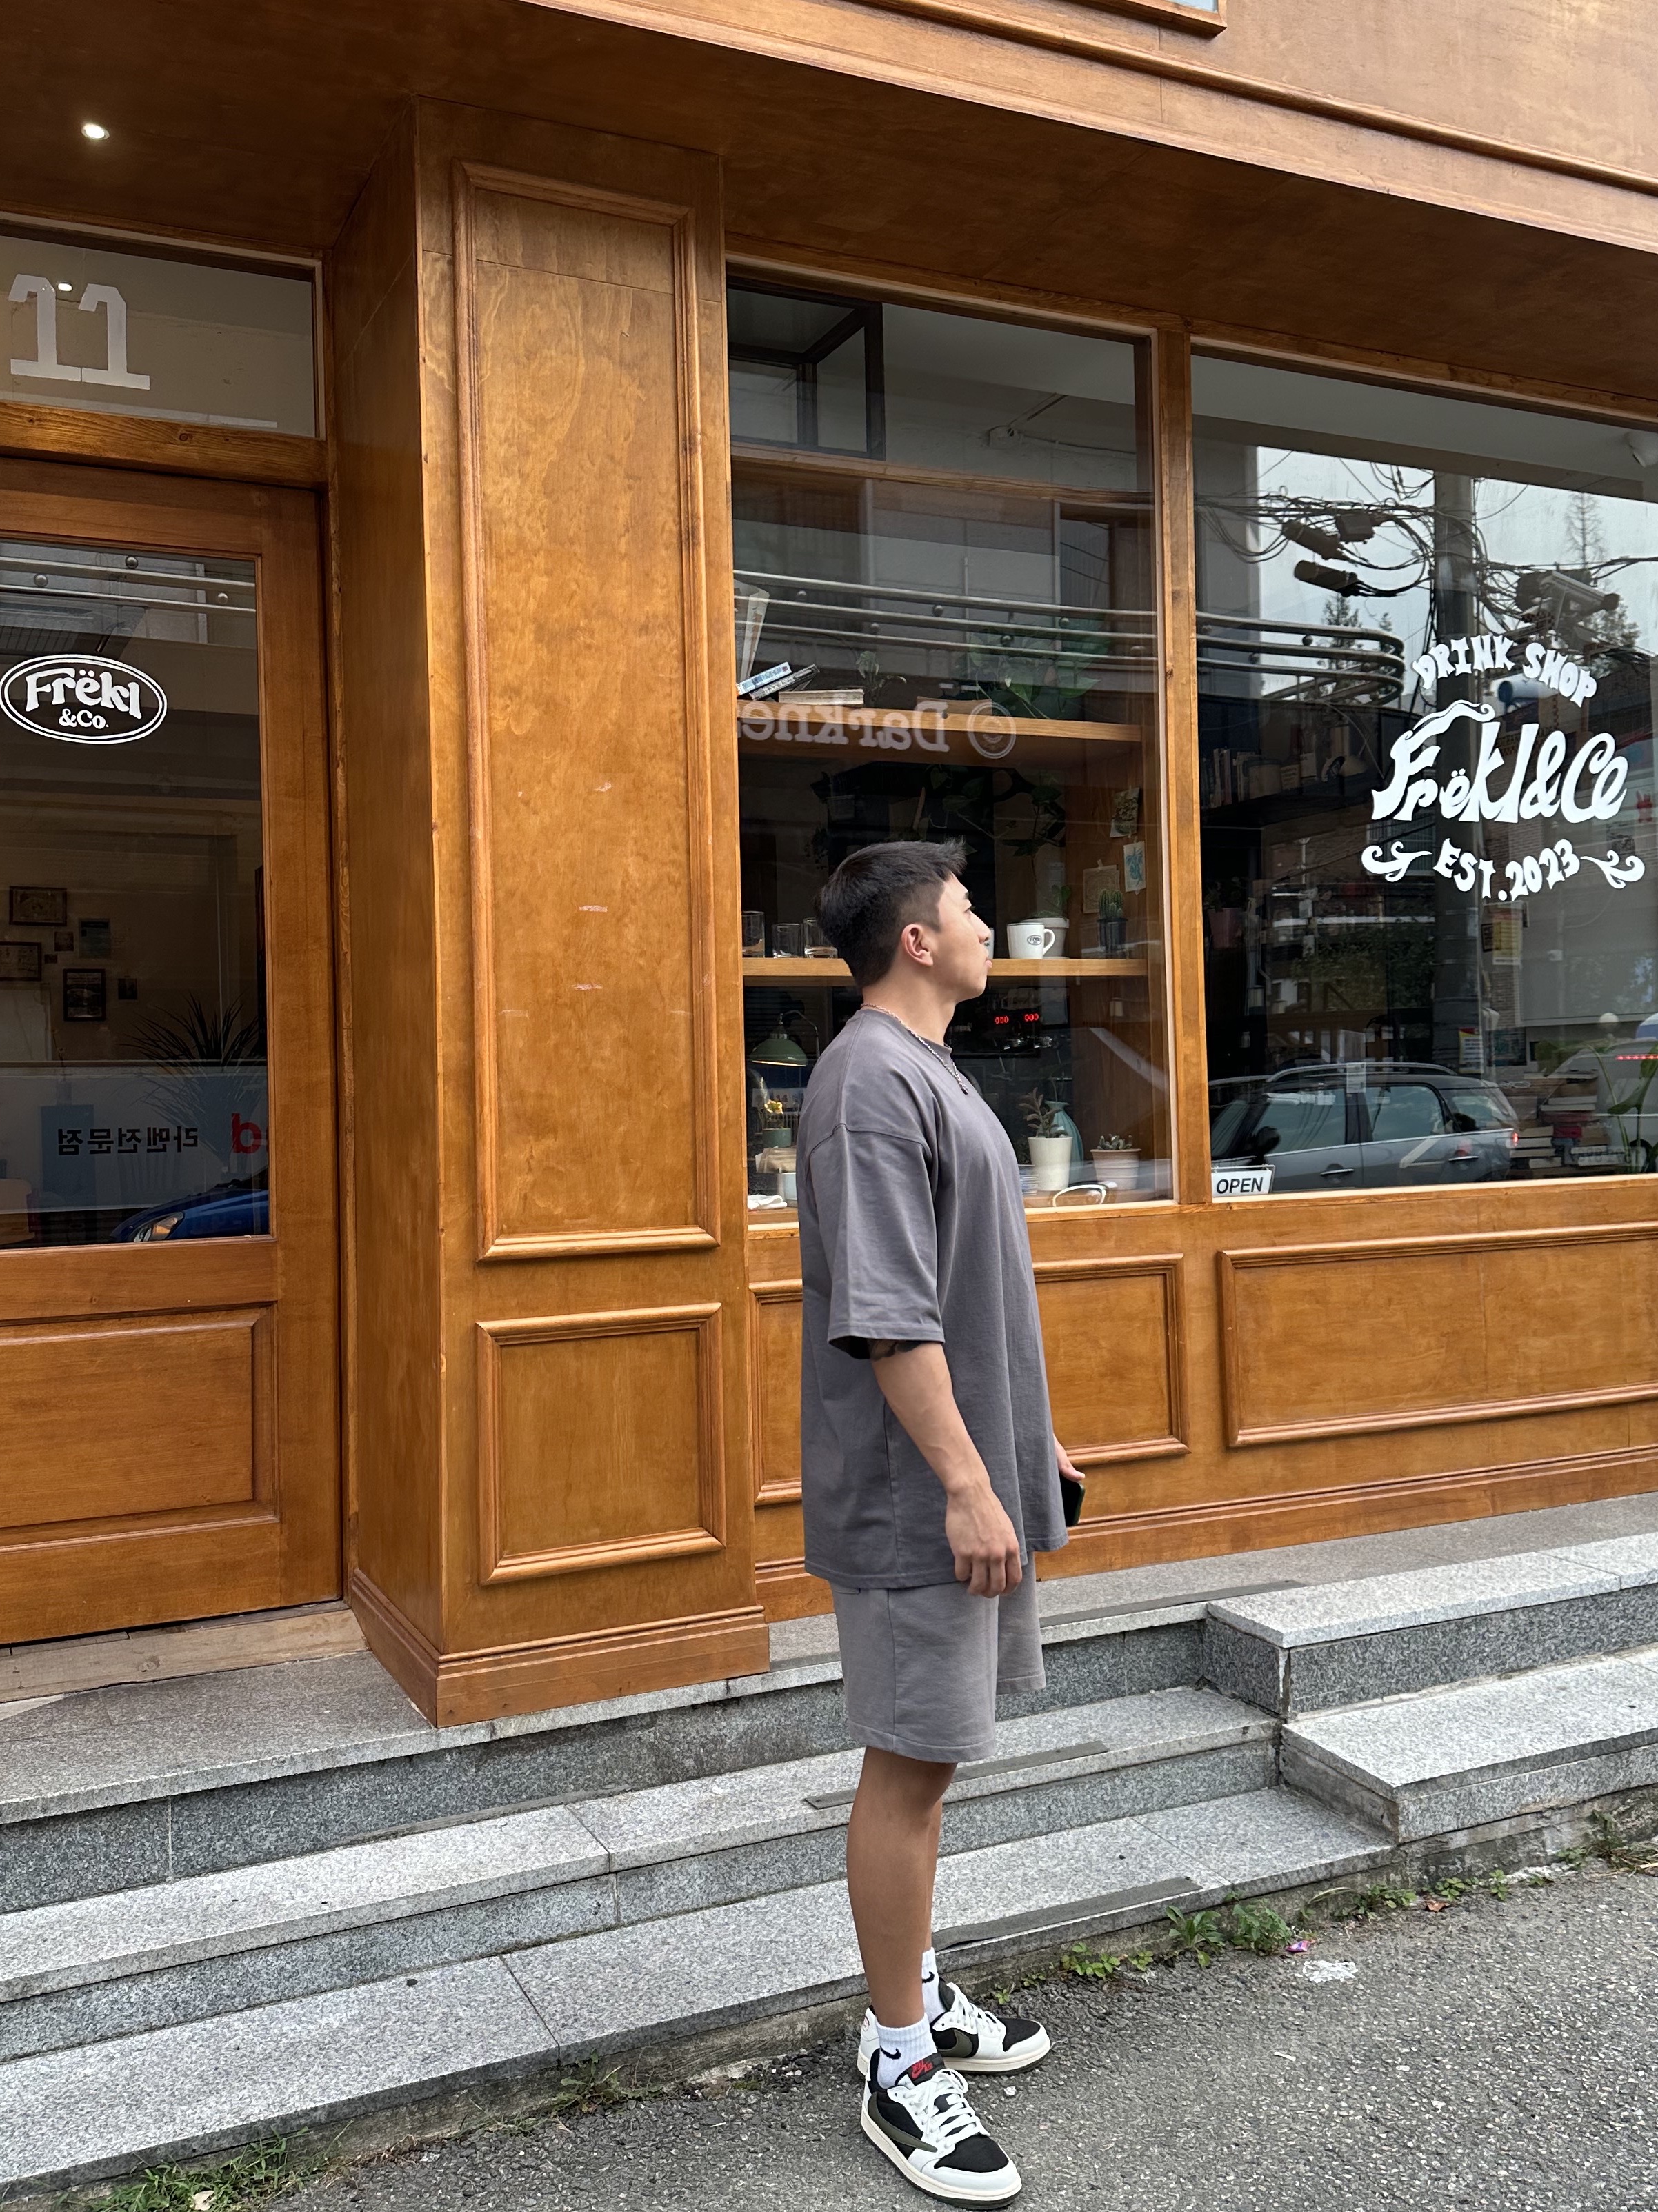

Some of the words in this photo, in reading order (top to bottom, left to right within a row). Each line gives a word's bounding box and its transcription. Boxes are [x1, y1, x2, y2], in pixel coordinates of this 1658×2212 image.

[8, 274, 150, 390] 11
[26, 668, 142, 719] Frëkl
[1411, 635, 1515, 689] DRINK
[1522, 643, 1597, 707] SHOP
[59, 708, 109, 730] &Co.
[1217, 1177, 1264, 1194] OPEN
